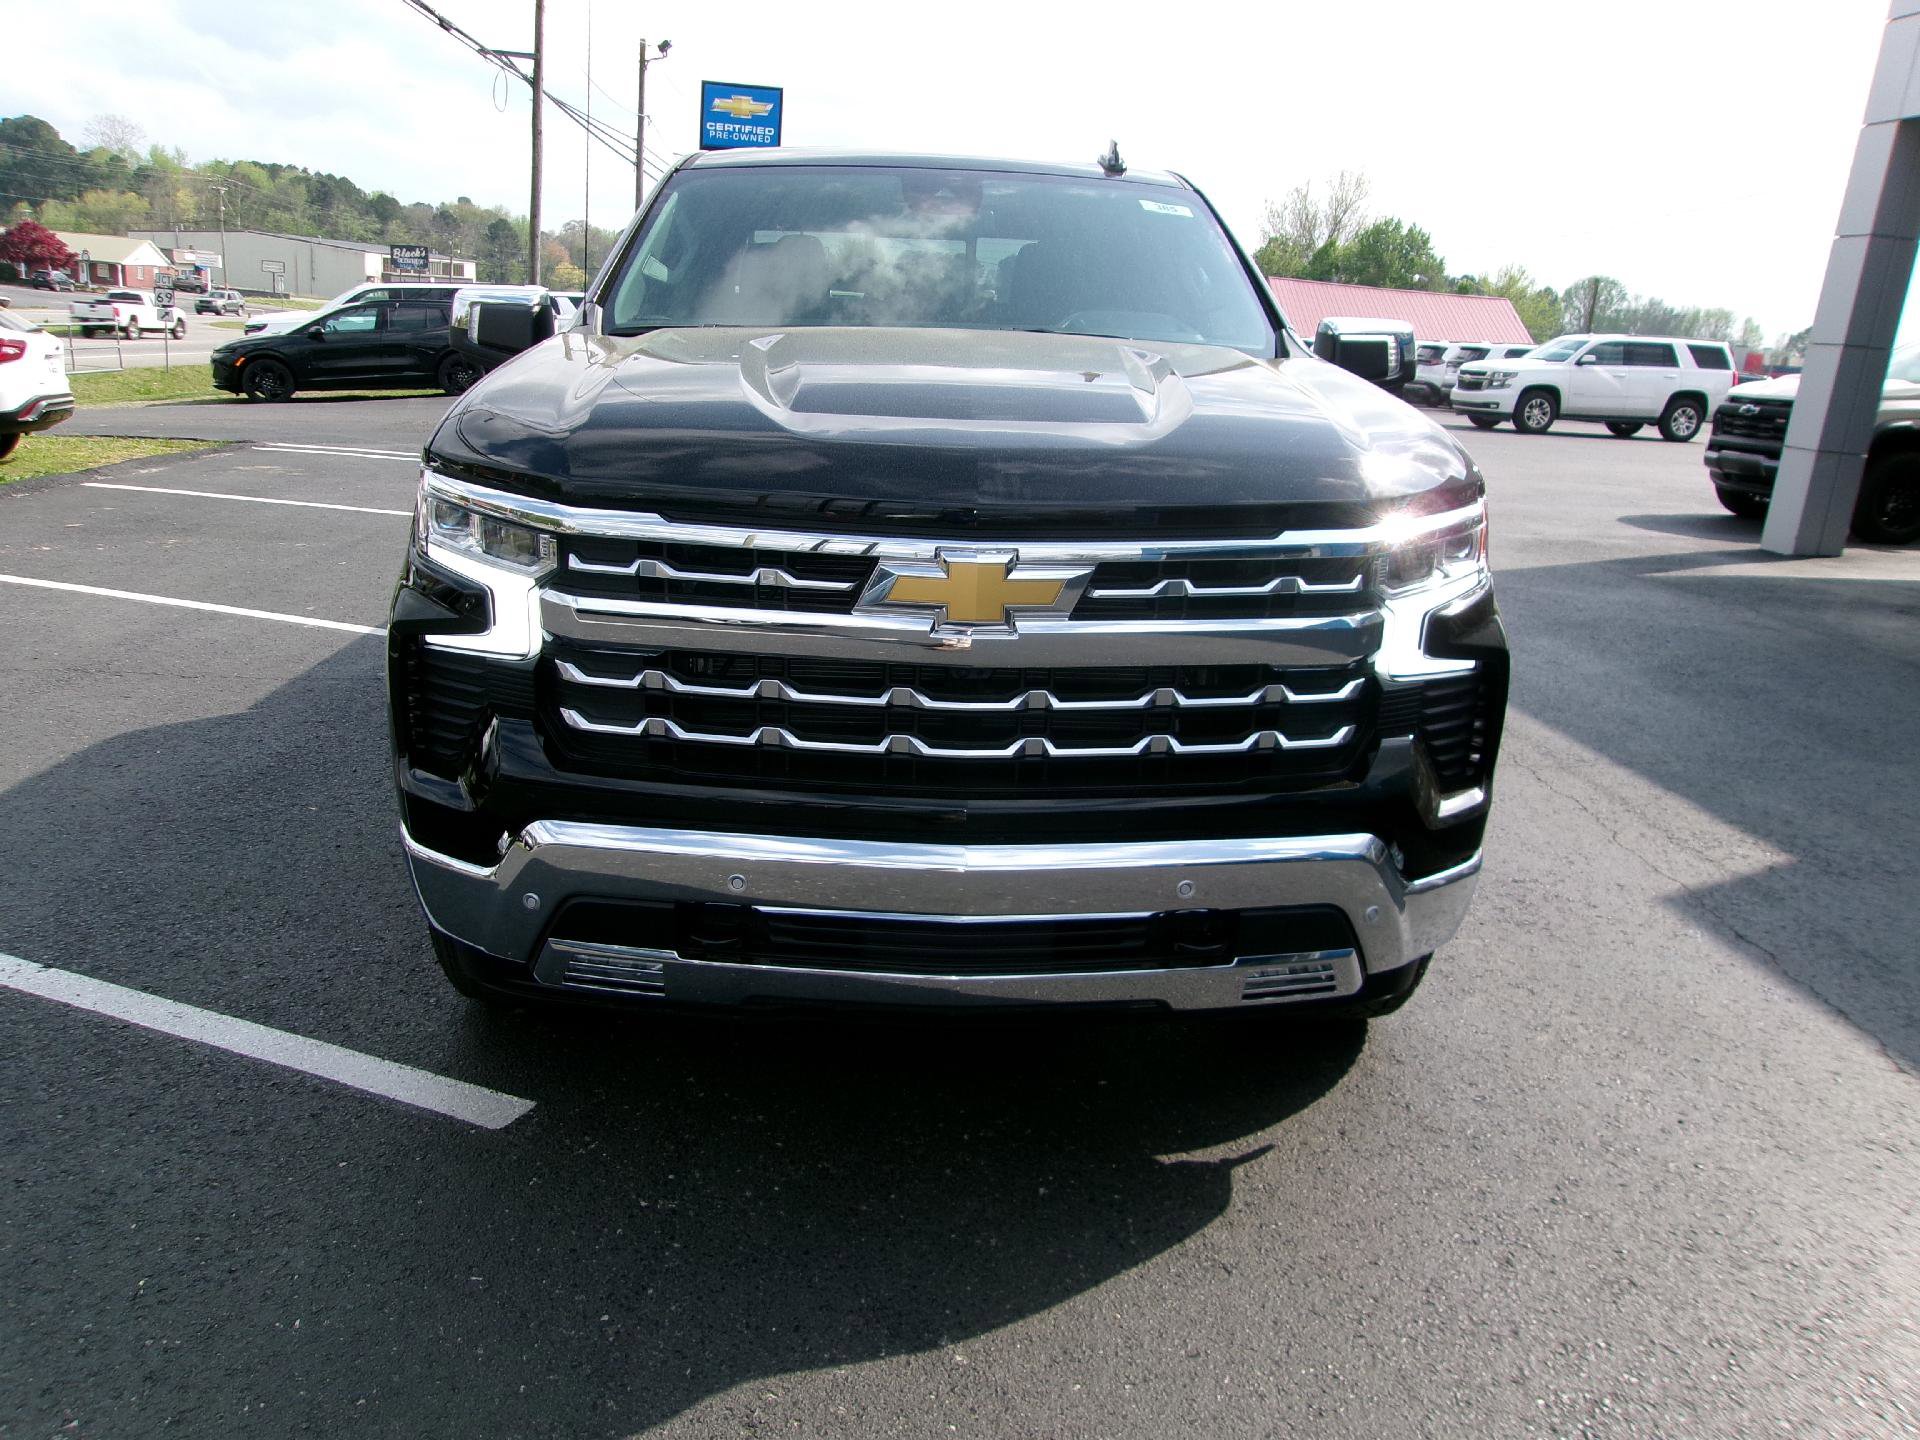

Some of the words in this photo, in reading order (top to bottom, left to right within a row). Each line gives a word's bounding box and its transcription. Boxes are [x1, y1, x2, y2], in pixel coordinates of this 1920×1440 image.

[706, 122, 775, 136] CERTIFIED
[709, 130, 771, 144] PRE-OWNED
[392, 247, 426, 259] Black's
[156, 274, 171, 285] JCT
[156, 292, 173, 304] 69
